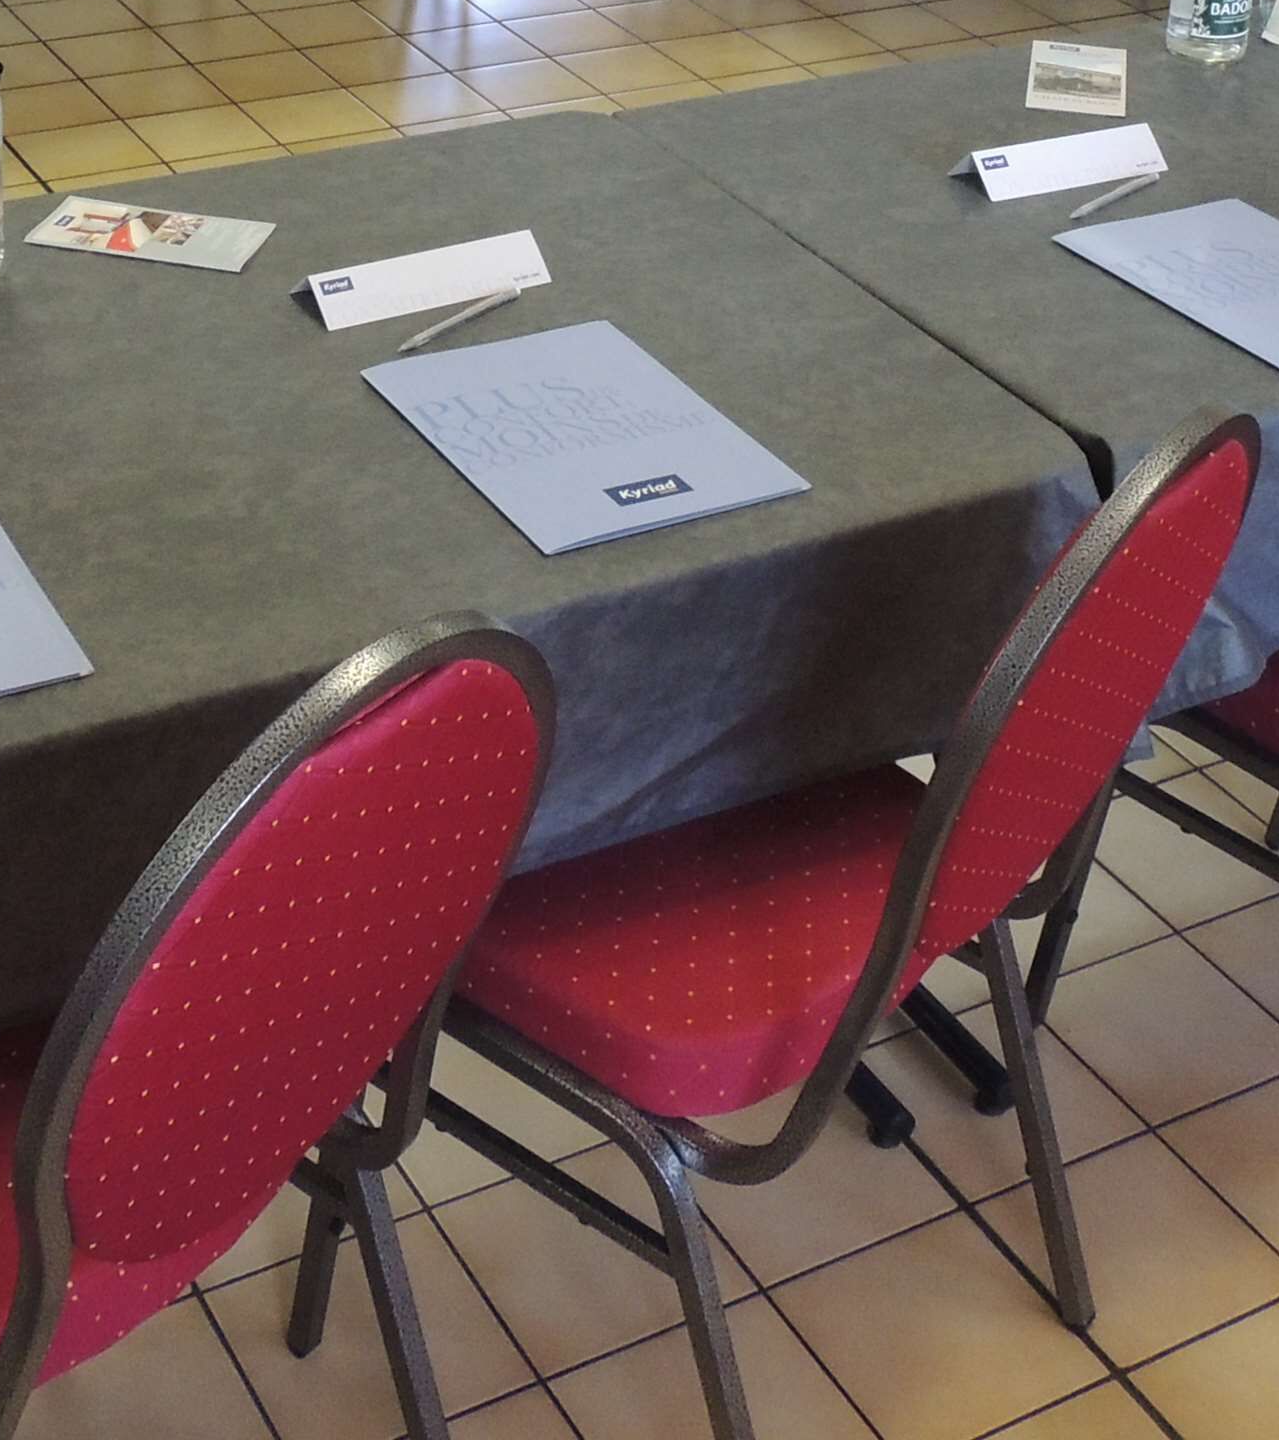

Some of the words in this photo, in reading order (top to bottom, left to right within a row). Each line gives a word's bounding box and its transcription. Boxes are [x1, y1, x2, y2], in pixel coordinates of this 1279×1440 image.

[1210, 0, 1248, 16] BADO
[411, 377, 587, 430] PLUS
[618, 479, 677, 501] Kyriad
